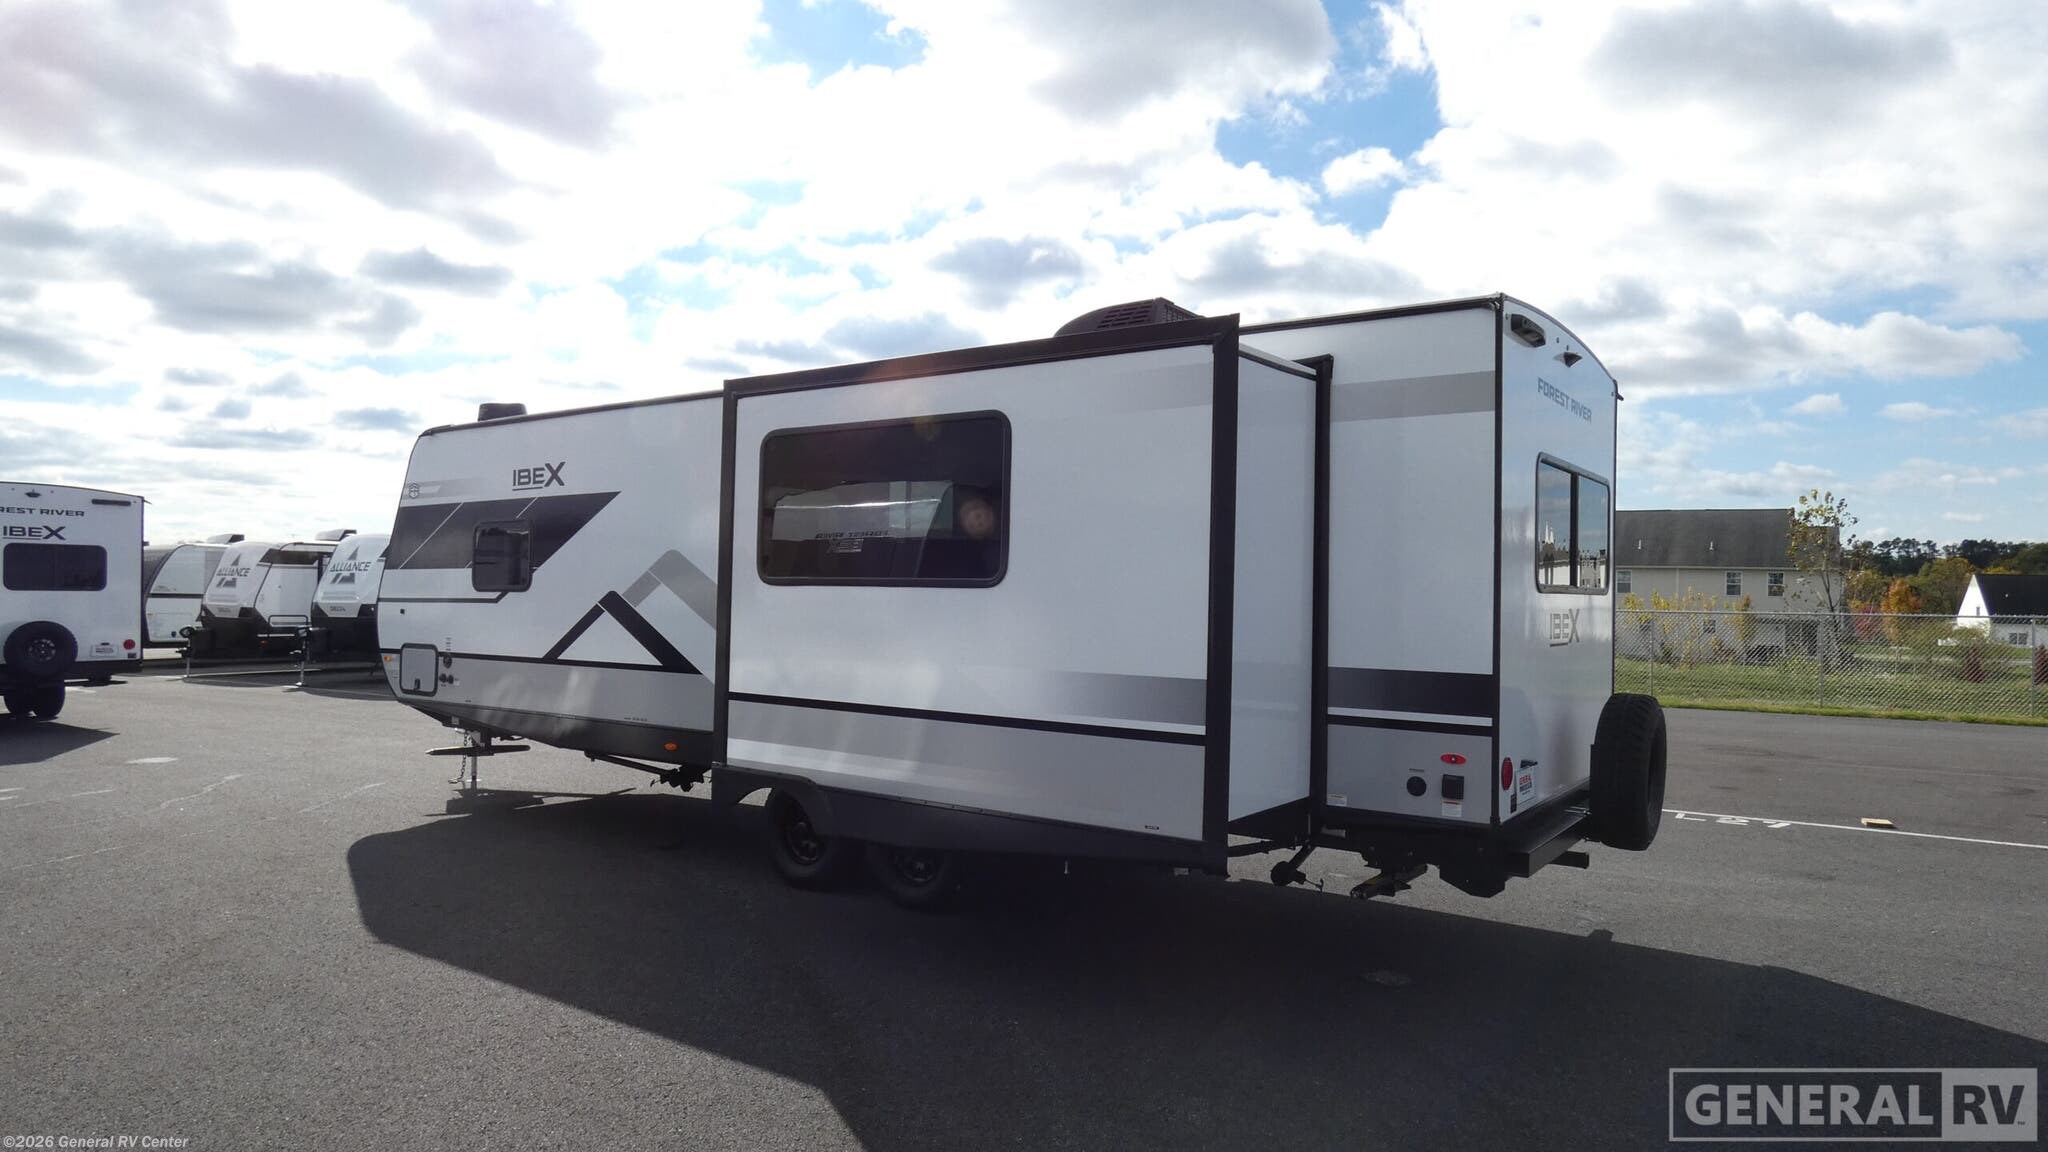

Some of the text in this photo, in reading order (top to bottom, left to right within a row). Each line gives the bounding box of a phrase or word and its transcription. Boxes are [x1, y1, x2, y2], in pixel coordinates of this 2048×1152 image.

[1538, 377, 1592, 424] FOREST RIVER
[512, 461, 566, 487] IBEX
[40, 509, 85, 517] RIVER
[3, 525, 66, 540] IBEX
[216, 567, 251, 576] ALLIANCE
[330, 561, 371, 572] ALLIANCE
[1550, 608, 1580, 643] IBEX
